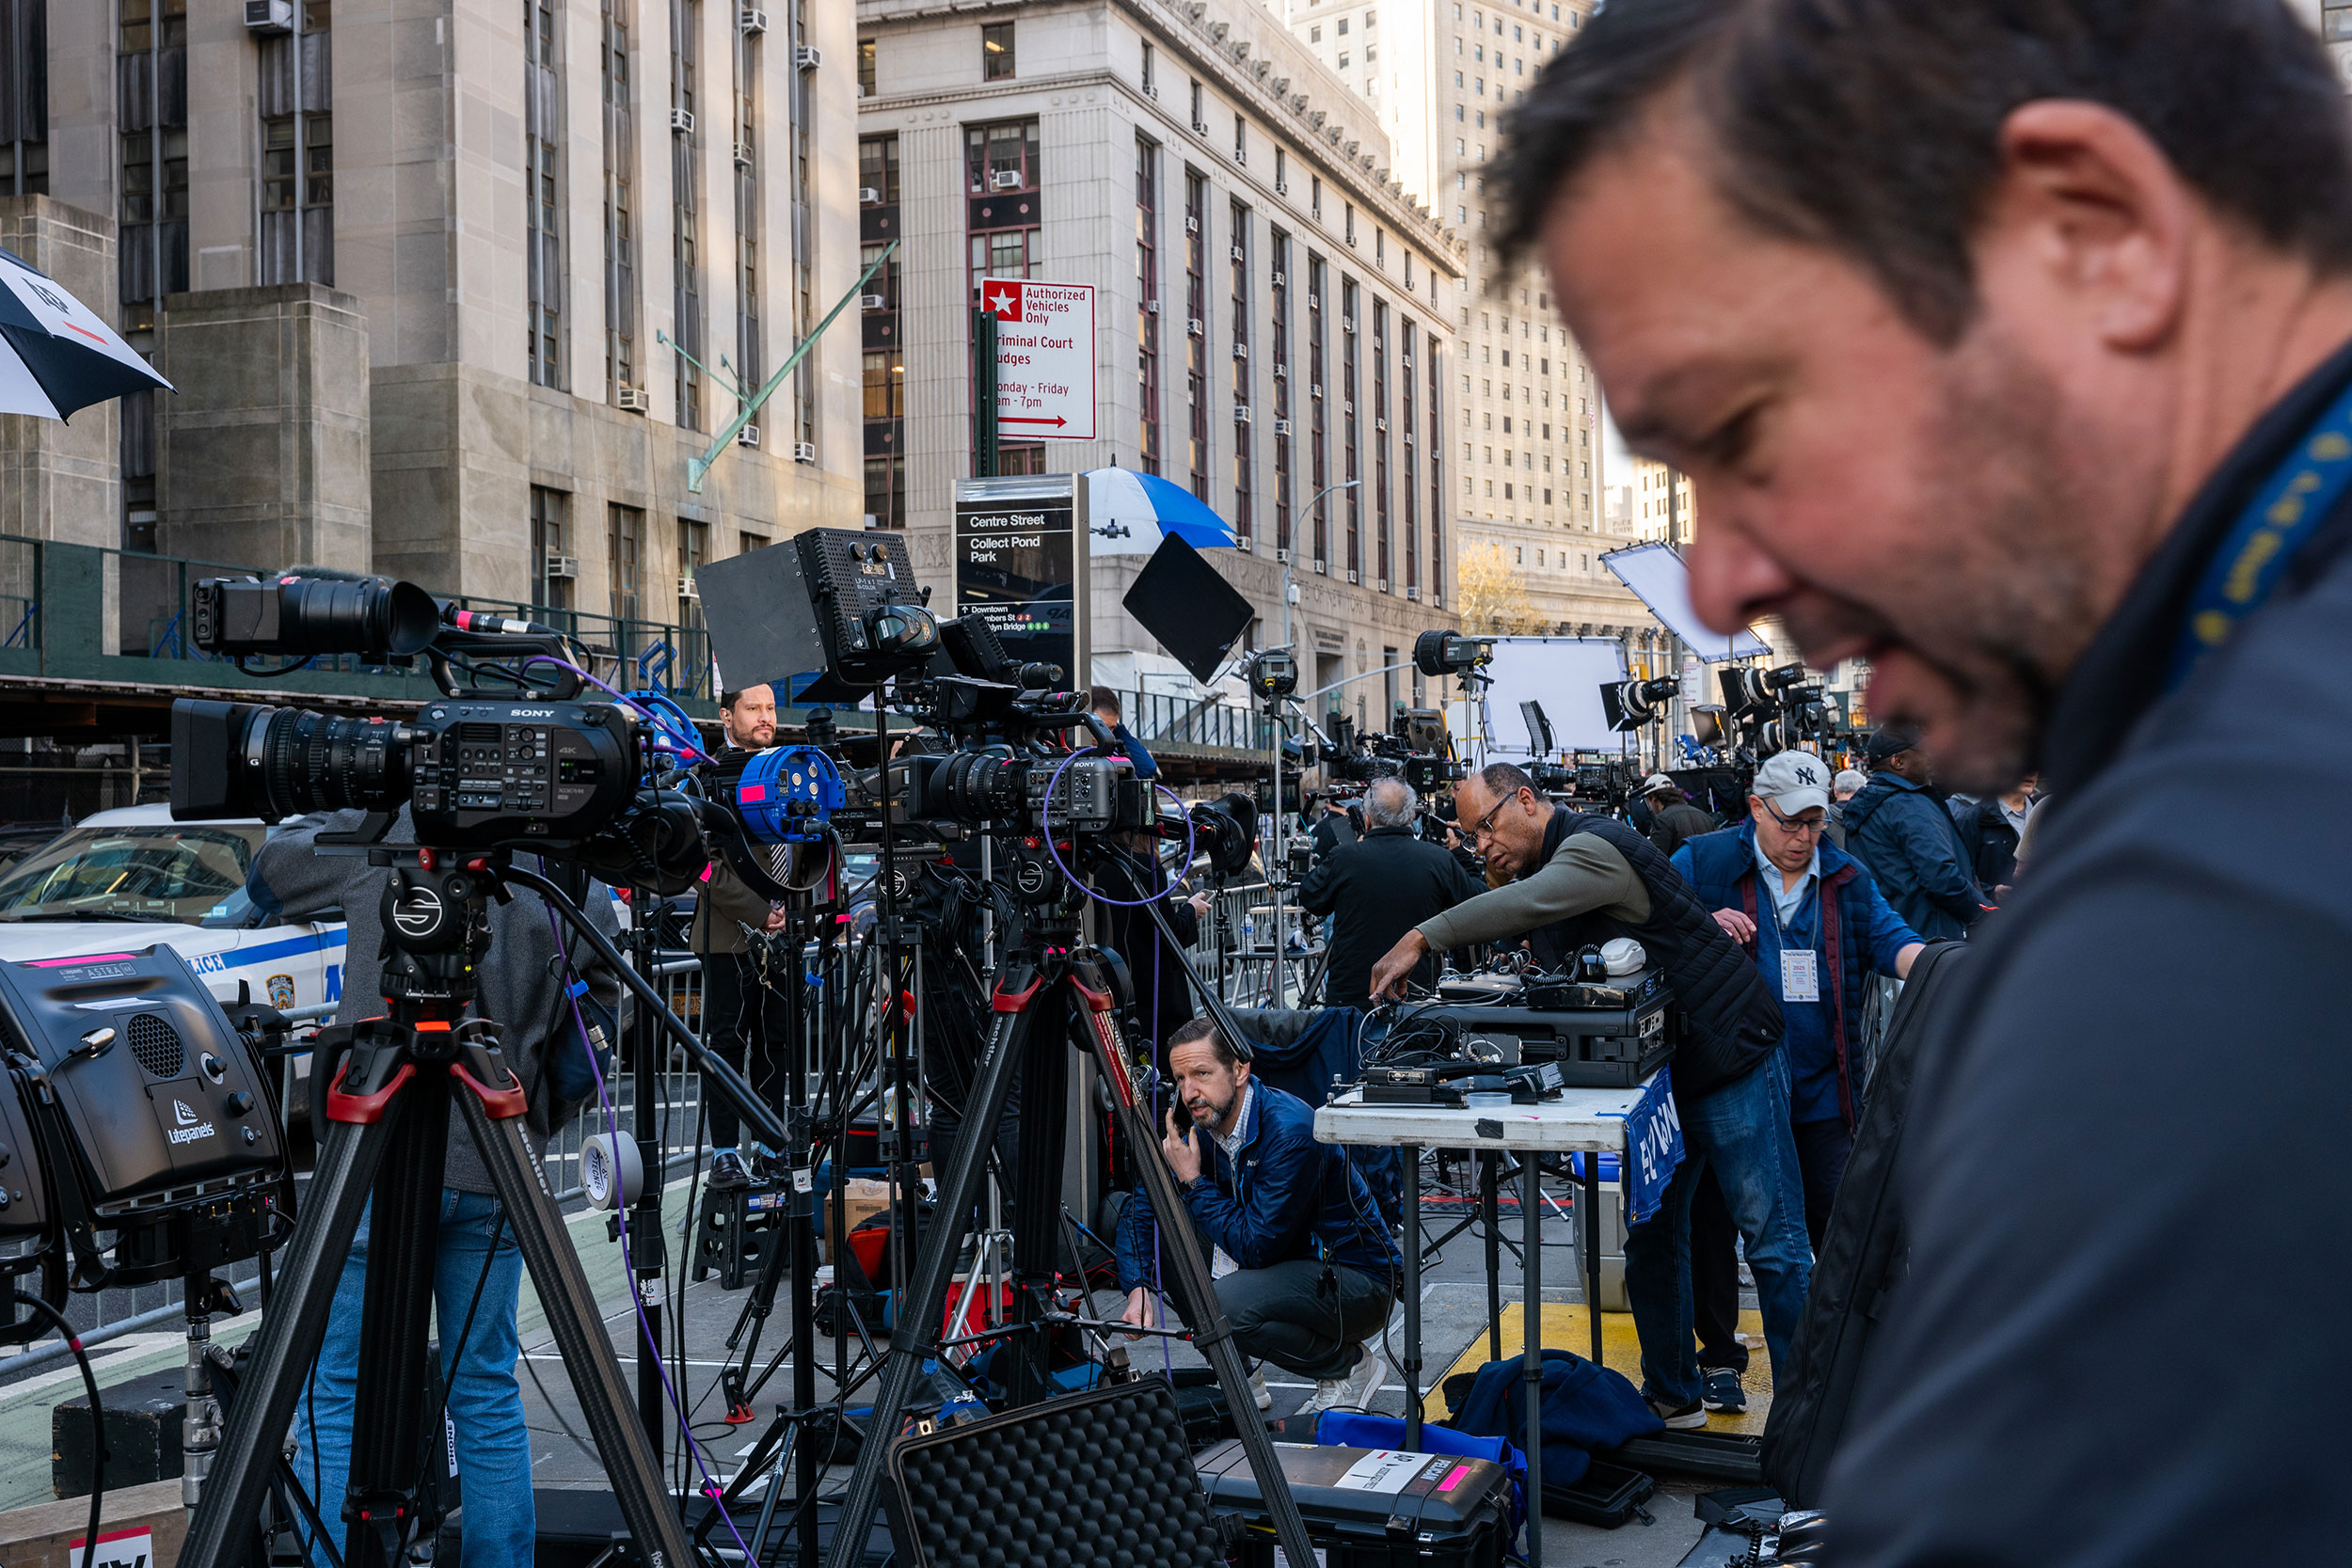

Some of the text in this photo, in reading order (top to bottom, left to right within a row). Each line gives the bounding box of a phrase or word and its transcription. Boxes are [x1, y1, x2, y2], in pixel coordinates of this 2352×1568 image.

[1025, 287, 1086, 301] Authorized
[1025, 300, 1069, 312] Vehicles
[1025, 312, 1049, 326] Only
[997, 334, 1073, 349] riminal Court
[997, 352, 1031, 366] udges
[997, 381, 1027, 395] onday
[1038, 383, 1069, 397] Friday
[997, 397, 1010, 406] am
[1021, 396, 1042, 409] 7pm
[970, 514, 1045, 528] Centre Street
[970, 535, 1041, 549] Collect Pond
[971, 550, 996, 562] Park
[1007, 613, 1015, 622] St
[1003, 623, 1026, 631] Bridge
[510, 709, 555, 718] SONY
[1795, 767, 1818, 785] NY
[87, 966, 122, 977] ASTRA
[984, 1016, 1003, 1068] sachtler
[167, 1121, 215, 1145] Litepanels
[517, 1122, 550, 1197] sachtler
